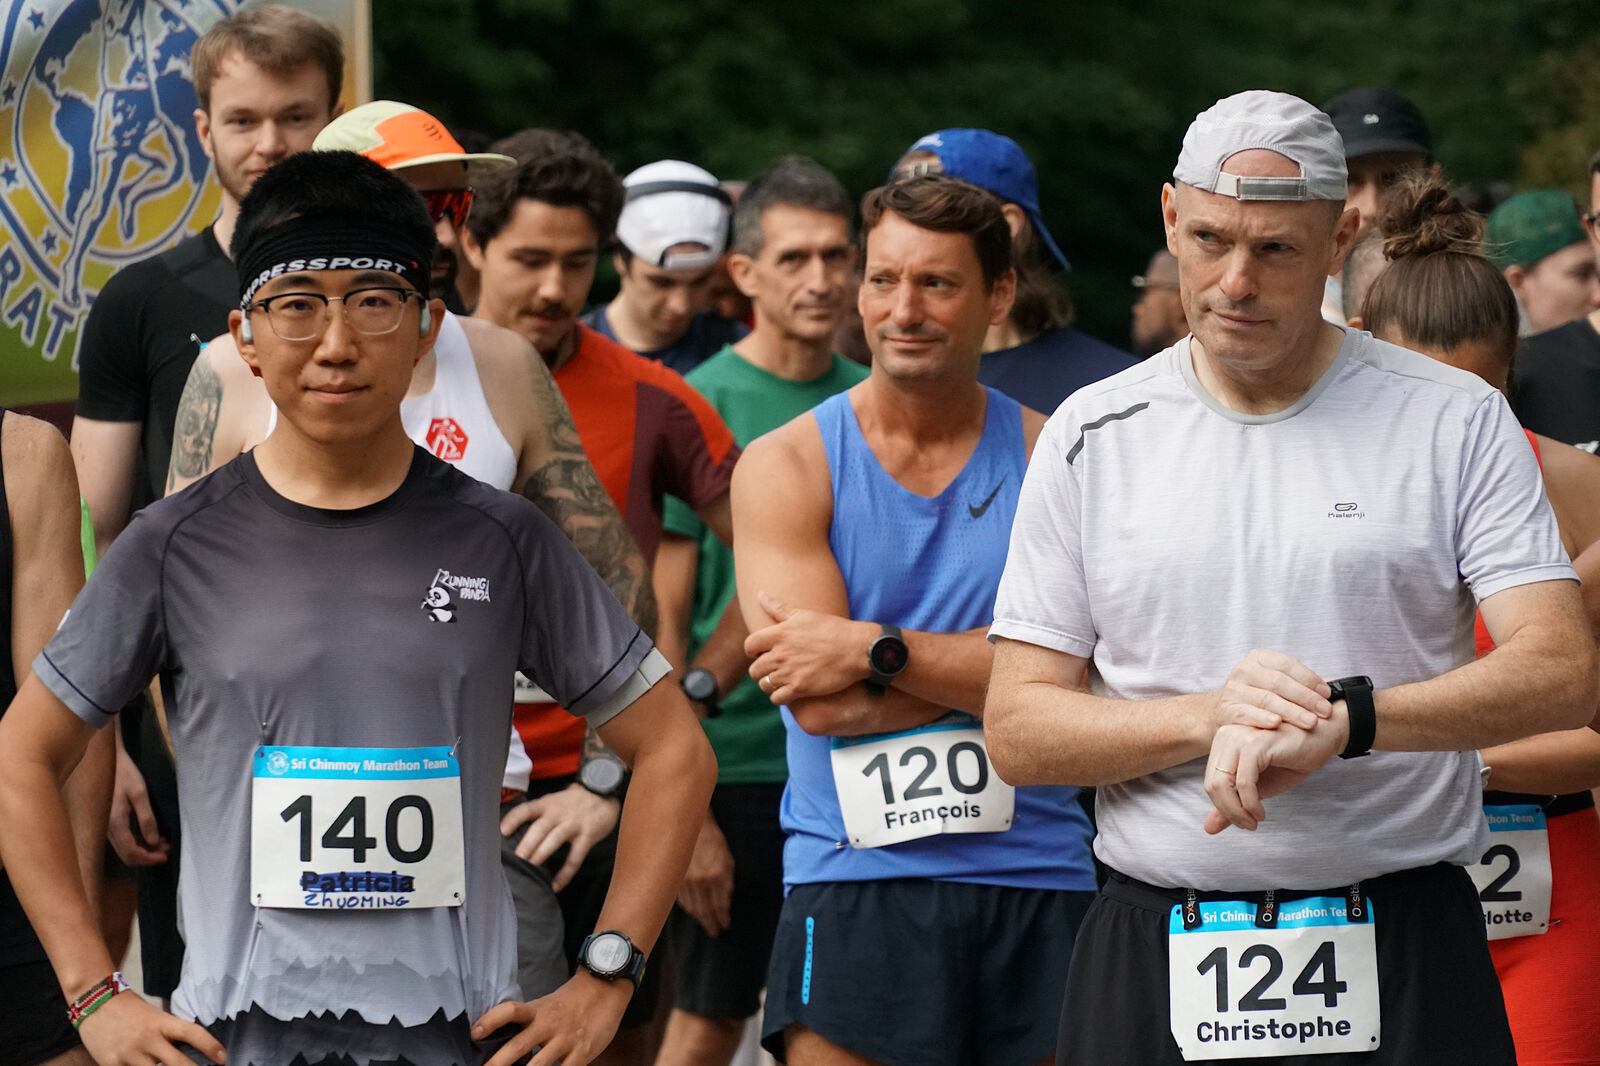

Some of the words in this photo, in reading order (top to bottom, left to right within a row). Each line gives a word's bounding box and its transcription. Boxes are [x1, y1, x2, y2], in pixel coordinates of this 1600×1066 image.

[460, 580, 490, 602] PANDA
[291, 758, 306, 770] Sri
[309, 758, 360, 774] Chinmoy
[363, 759, 420, 771] Marathon
[423, 759, 448, 770] Team
[862, 741, 989, 805] 120
[885, 801, 981, 829] François
[1509, 813, 1535, 824] Team
[280, 795, 434, 864] 140
[302, 870, 416, 893] Patricia
[1203, 911, 1217, 924] Sri
[1220, 909, 1256, 923] Chinm
[1330, 906, 1348, 918] Tea
[1484, 909, 1533, 925] lotte
[1197, 941, 1347, 1013] 124
[1197, 1016, 1351, 1043] Christophe
